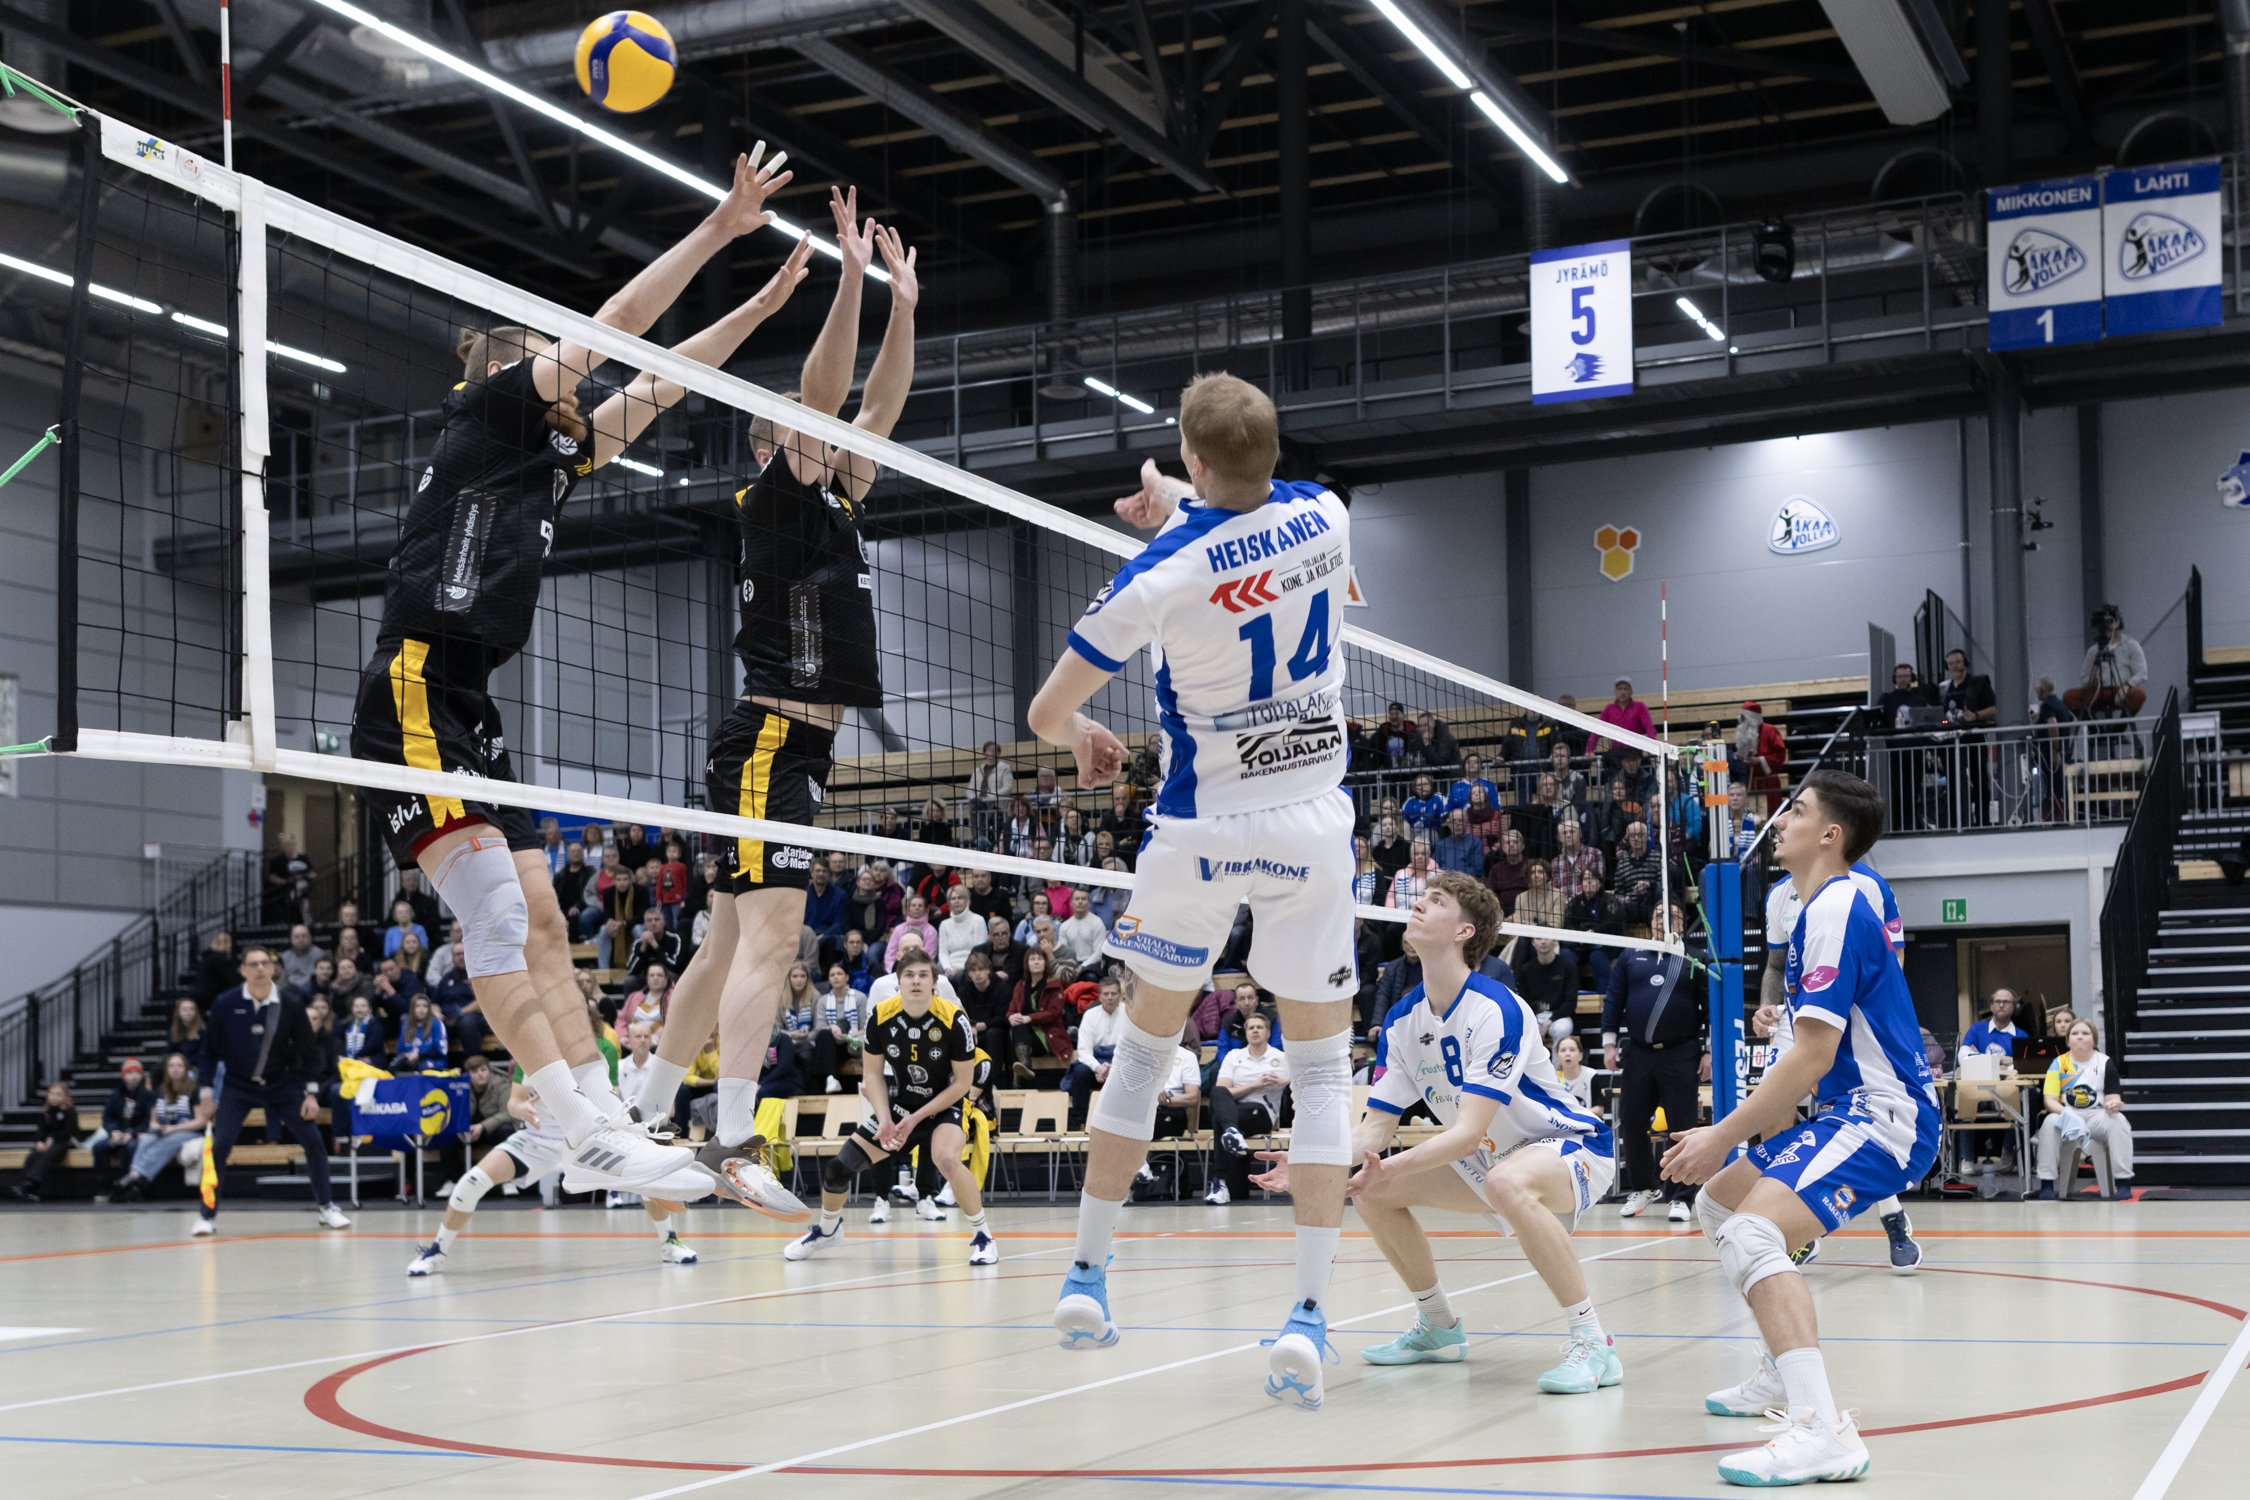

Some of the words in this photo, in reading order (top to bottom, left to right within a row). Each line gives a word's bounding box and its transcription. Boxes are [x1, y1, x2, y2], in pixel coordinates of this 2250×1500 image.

[136, 140, 165, 161] HUCK
[2134, 173, 2189, 193] LAHTI
[1996, 187, 2092, 213] MIKKONEN
[1555, 259, 1609, 284] JYRÄMÖ
[1571, 285, 1596, 346] 5
[2035, 308, 2055, 344] 1
[1206, 510, 1330, 573] HEISKANEN
[1280, 573, 1304, 593] KONE
[1305, 566, 1318, 585] JA
[1315, 551, 1345, 579] KULJETUS
[1301, 551, 1328, 569] TOIJALAN
[1238, 588, 1331, 702] 14
[1240, 734, 1343, 770] TOIJALAN
[1240, 753, 1334, 780] RAKENNUSTARVIKE
[910, 1043, 919, 1062] 5
[1440, 1034, 1464, 1087] 8
